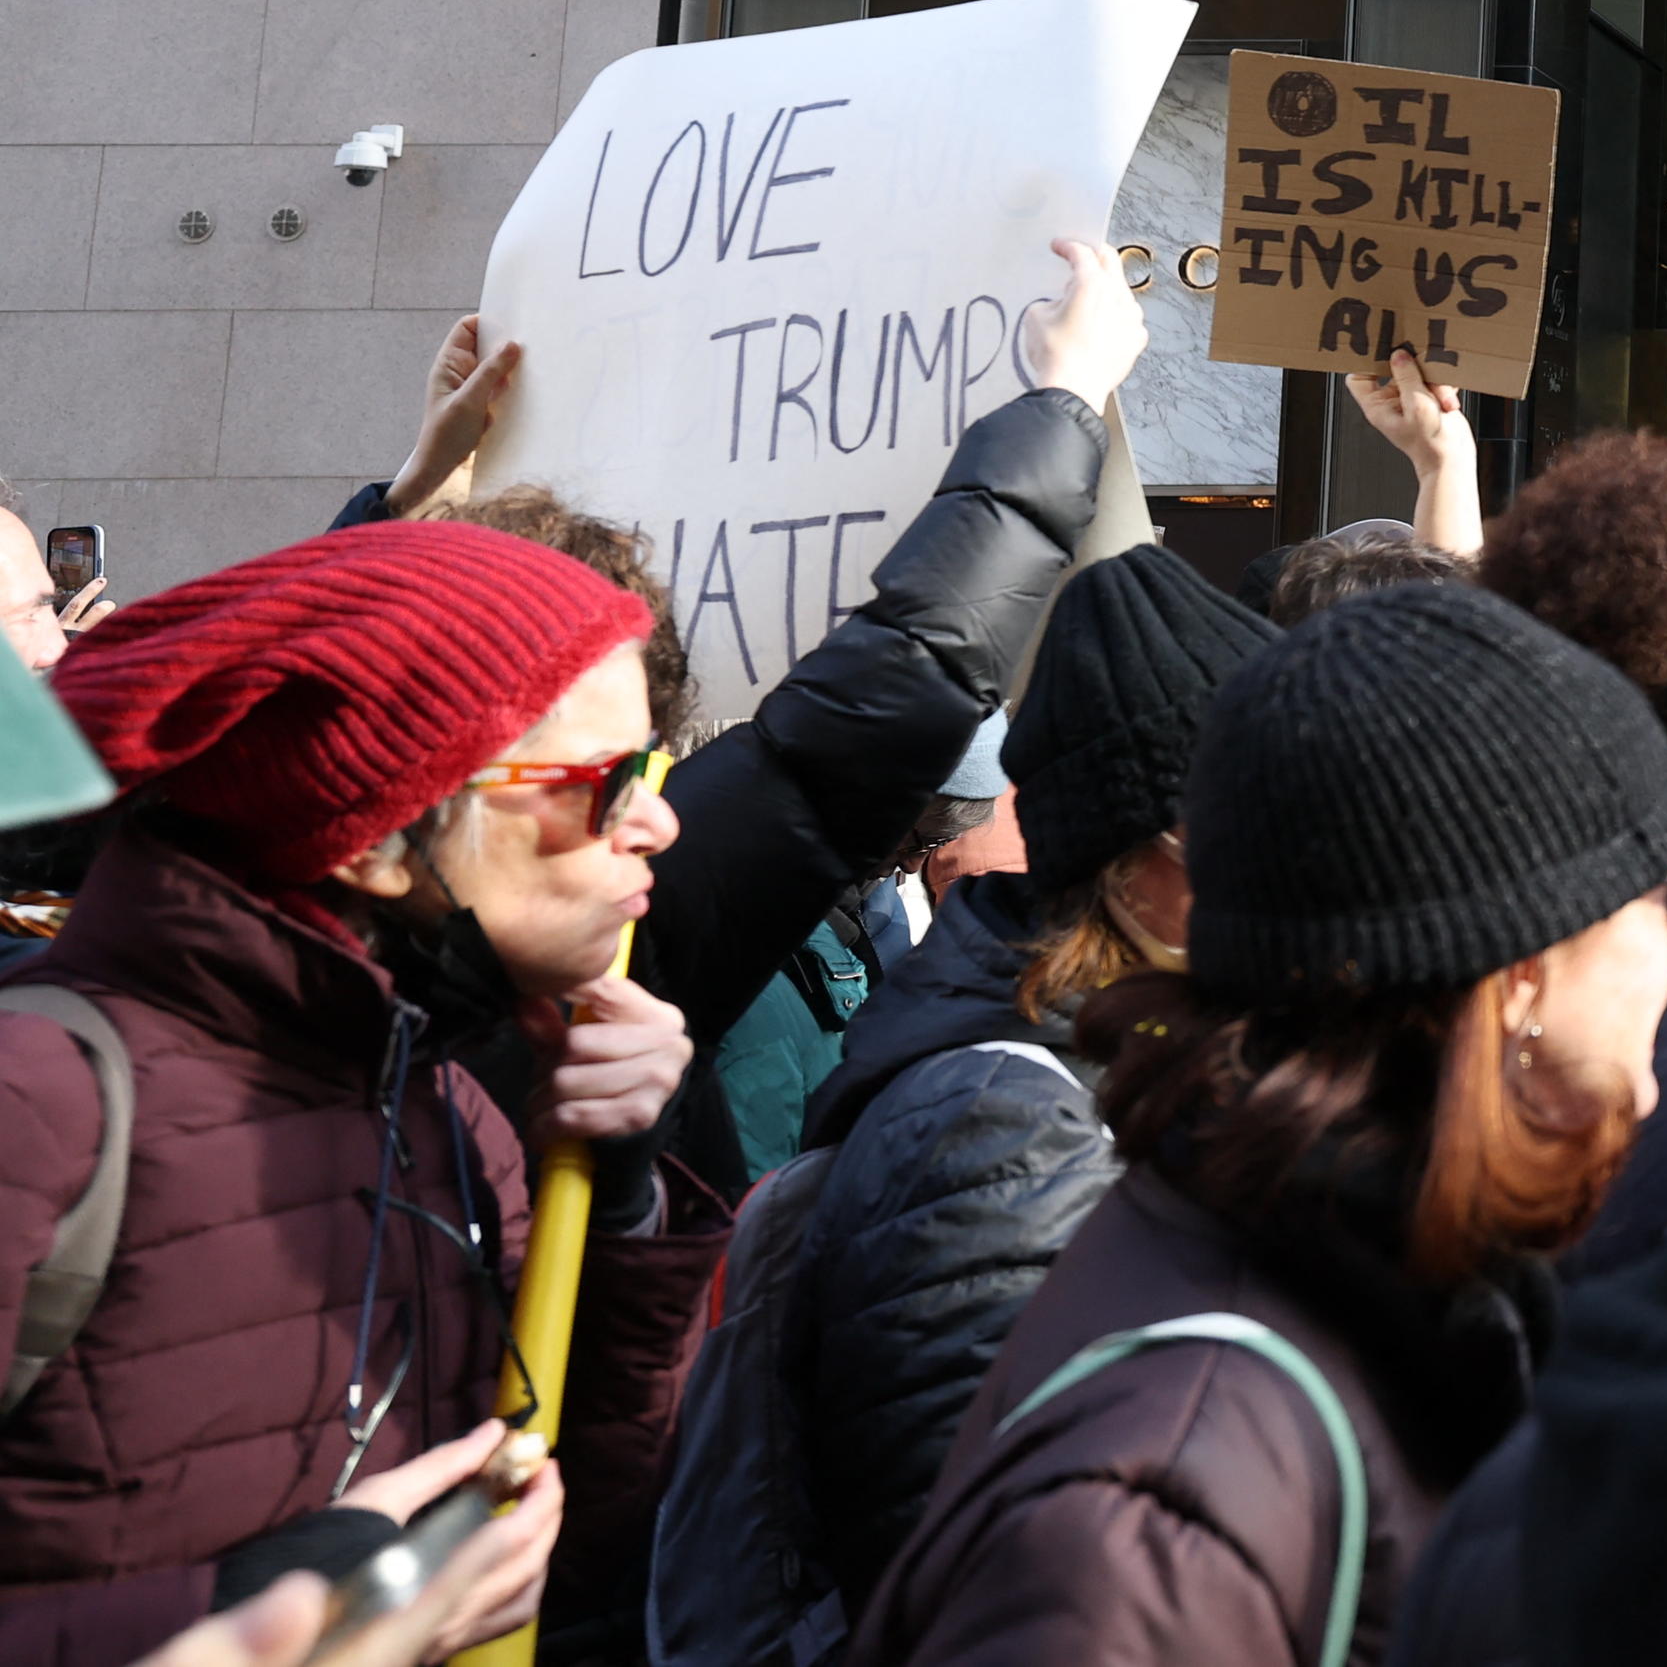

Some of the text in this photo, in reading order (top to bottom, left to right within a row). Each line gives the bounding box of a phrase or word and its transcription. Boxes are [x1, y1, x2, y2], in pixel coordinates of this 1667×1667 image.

[1267, 70, 1470, 155] OIL
[578, 98, 850, 279] LOVE
[1238, 149, 1376, 216] IS
[1233, 224, 1518, 317] ING US
[1318, 296, 1459, 367] ALL
